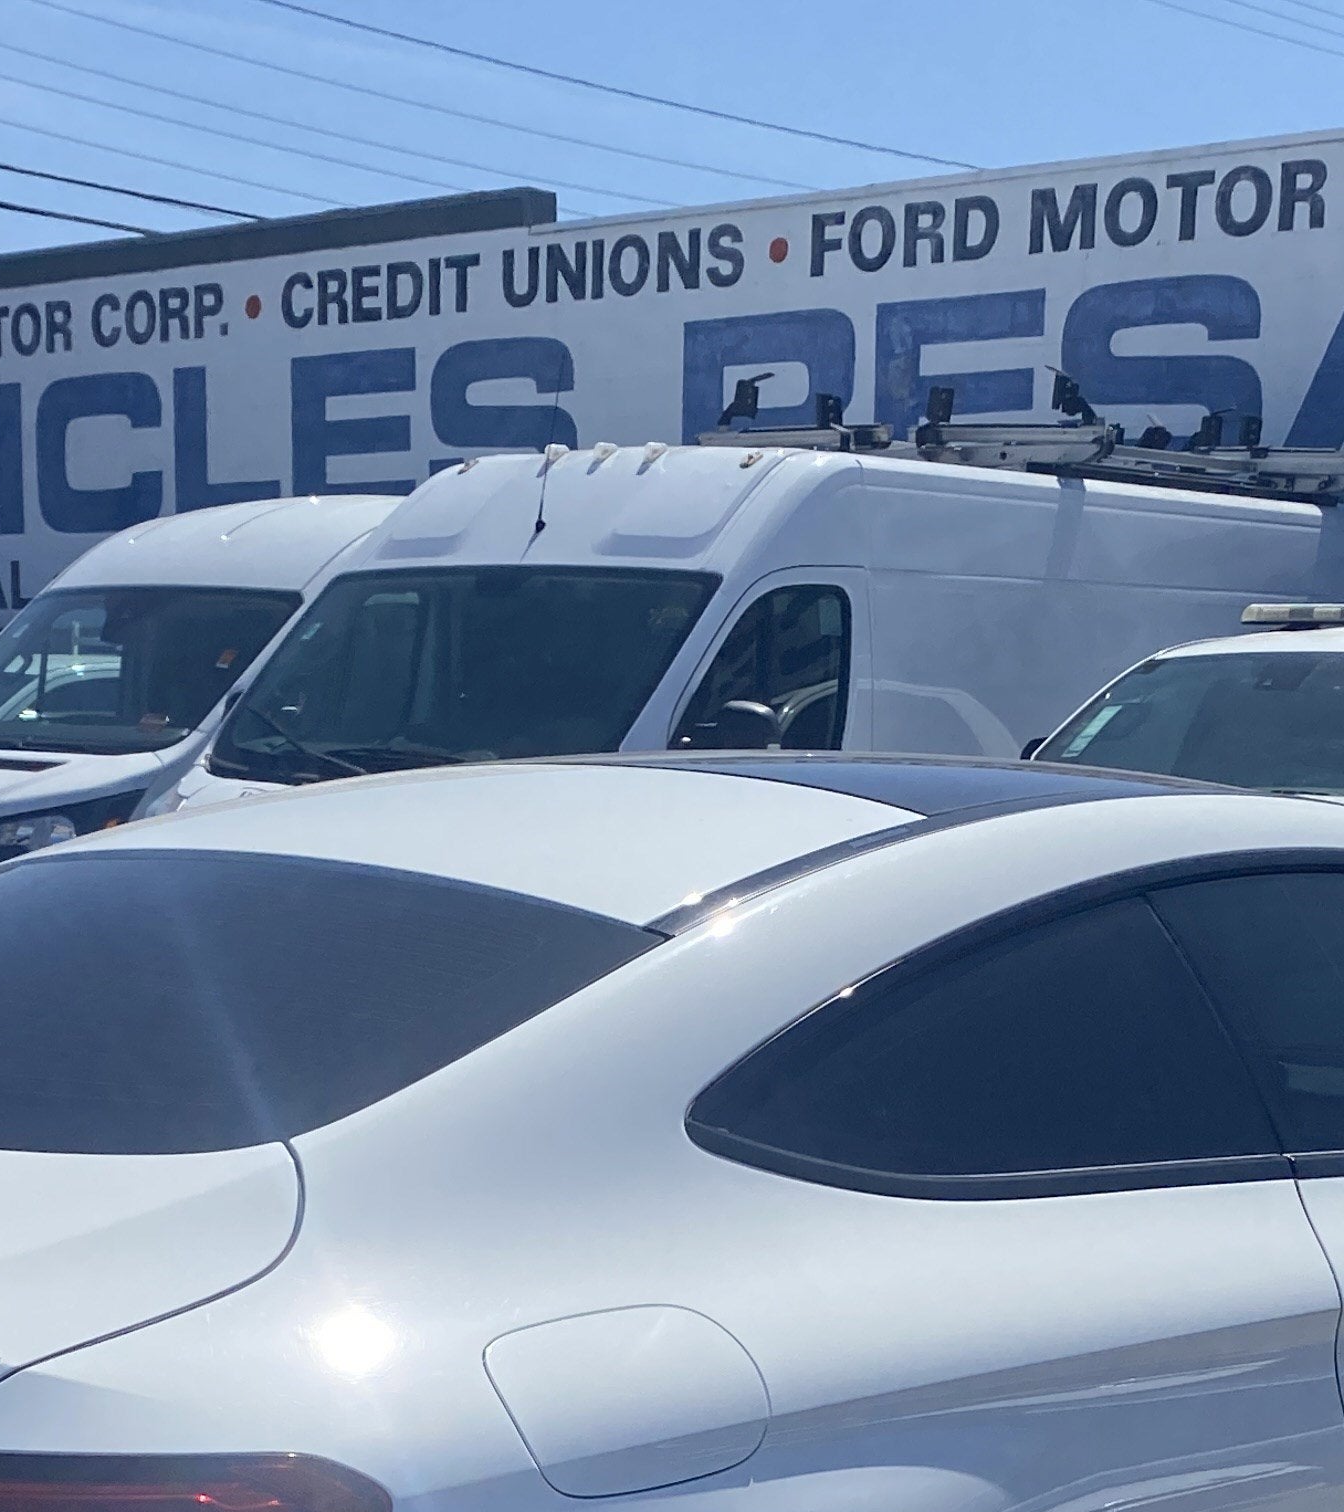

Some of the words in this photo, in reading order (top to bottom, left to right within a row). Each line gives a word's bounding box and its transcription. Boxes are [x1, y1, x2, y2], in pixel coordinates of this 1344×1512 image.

[91, 283, 229, 348] CORP.
[281, 252, 480, 330] CREDIT
[502, 222, 745, 307] UNIONS
[809, 195, 1000, 277] FORD
[1028, 158, 1328, 255] MOTOR
